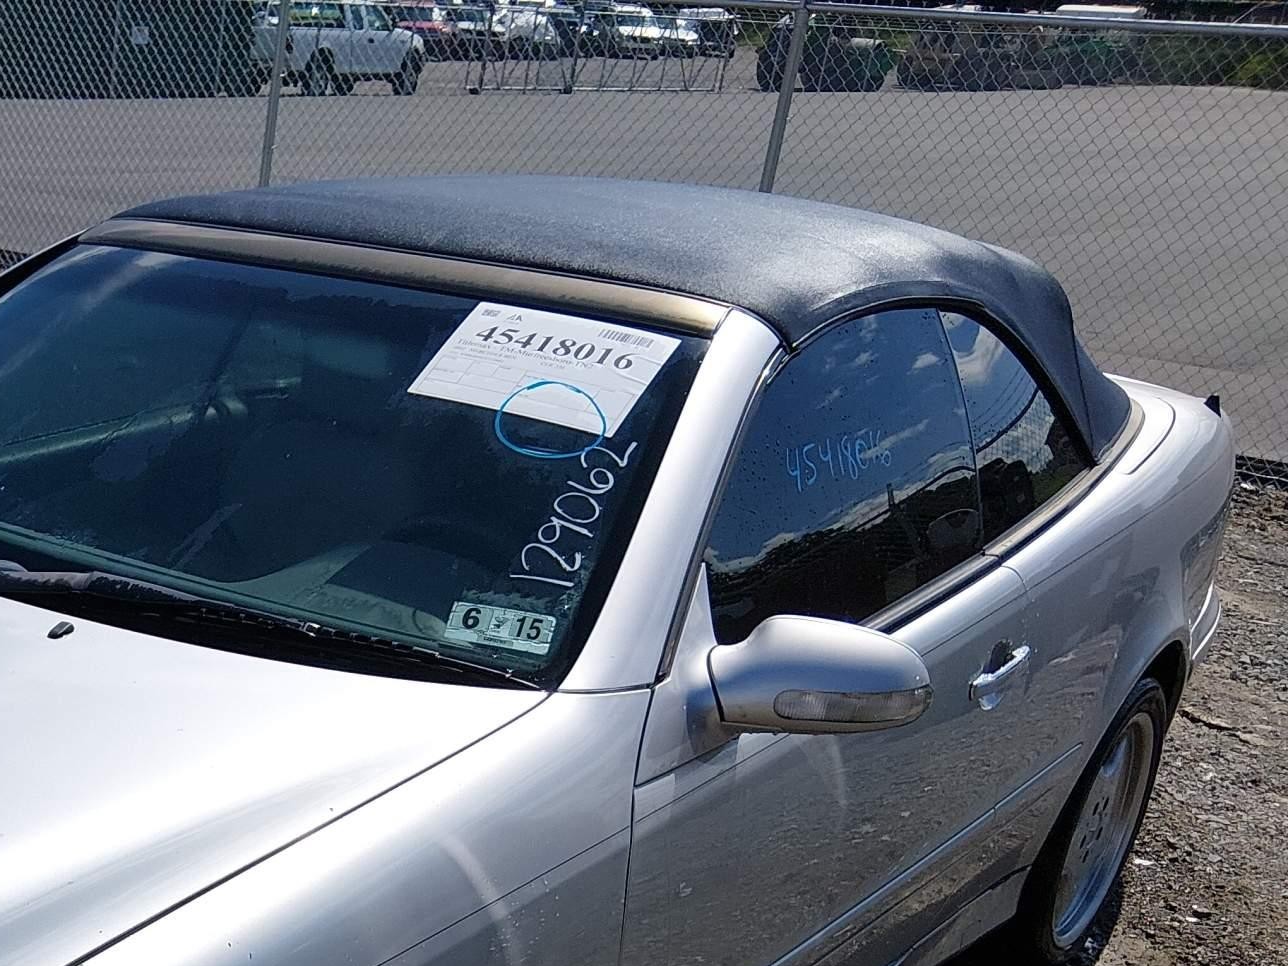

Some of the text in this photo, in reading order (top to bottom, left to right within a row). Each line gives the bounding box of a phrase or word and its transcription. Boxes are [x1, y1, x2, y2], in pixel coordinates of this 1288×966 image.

[475, 325, 635, 371] 45418016
[509, 440, 638, 588] 129062
[461, 607, 544, 640] 6 15
